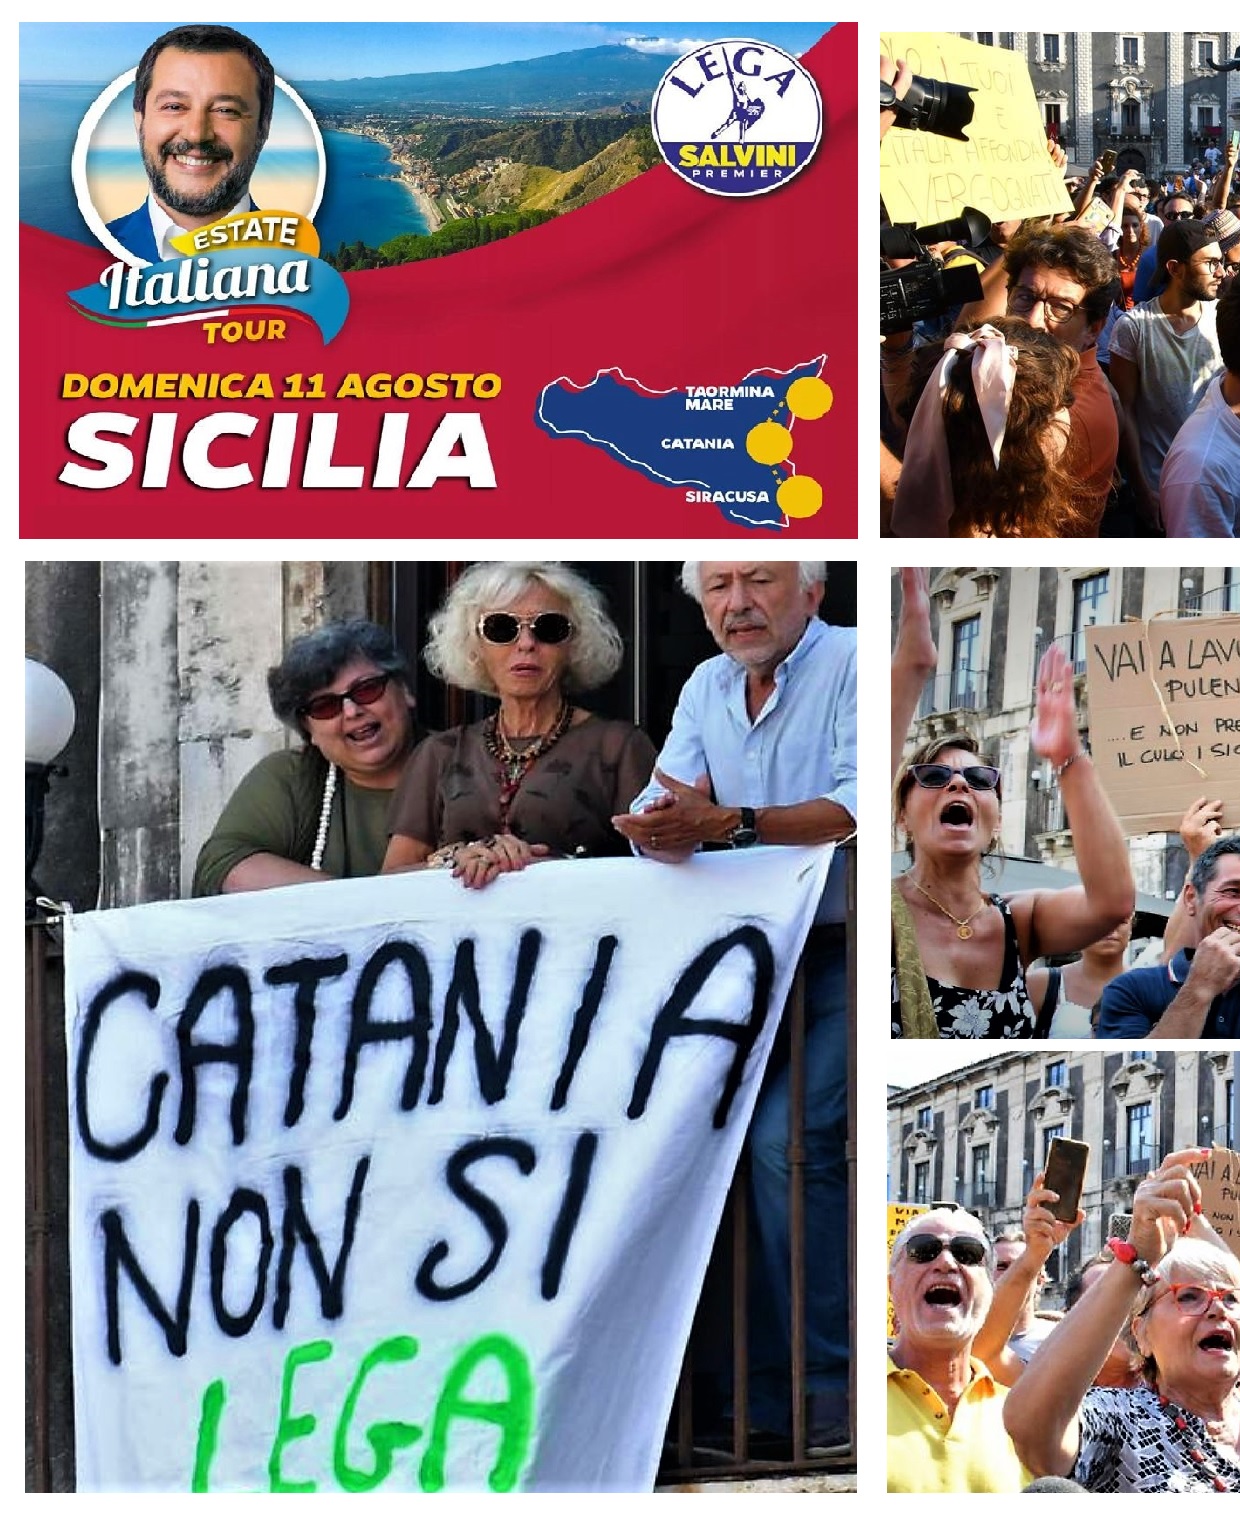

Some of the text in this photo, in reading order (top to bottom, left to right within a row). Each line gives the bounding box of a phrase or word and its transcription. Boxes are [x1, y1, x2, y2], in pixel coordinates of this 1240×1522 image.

[670, 47, 795, 98] LEGA
[679, 145, 795, 167] SALVINI
[692, 170, 782, 178] PREMIER
[194, 217, 299, 250] ESTATE
[100, 257, 309, 309] Italiana
[202, 320, 286, 344] TOUR
[62, 373, 502, 399] DOMENICA 11 AGOSTO
[685, 386, 775, 397] TAORMINA
[685, 399, 734, 410] MARE
[58, 411, 497, 489] SICILIA
[661, 438, 735, 449] CATANIA
[685, 491, 769, 503] SIRACUSA
[1094, 640, 1145, 682] VAI
[1159, 640, 1176, 670] A
[1159, 721, 1198, 737] NON
[1117, 751, 1134, 767] IL
[1140, 749, 1184, 764] CULO
[1197, 745, 1202, 760] I
[76, 925, 776, 1162] CATANIA
[1212, 1211, 1234, 1222] NON
[100, 1130, 599, 1366] NON SI
[191, 1333, 537, 1493] LEGA
